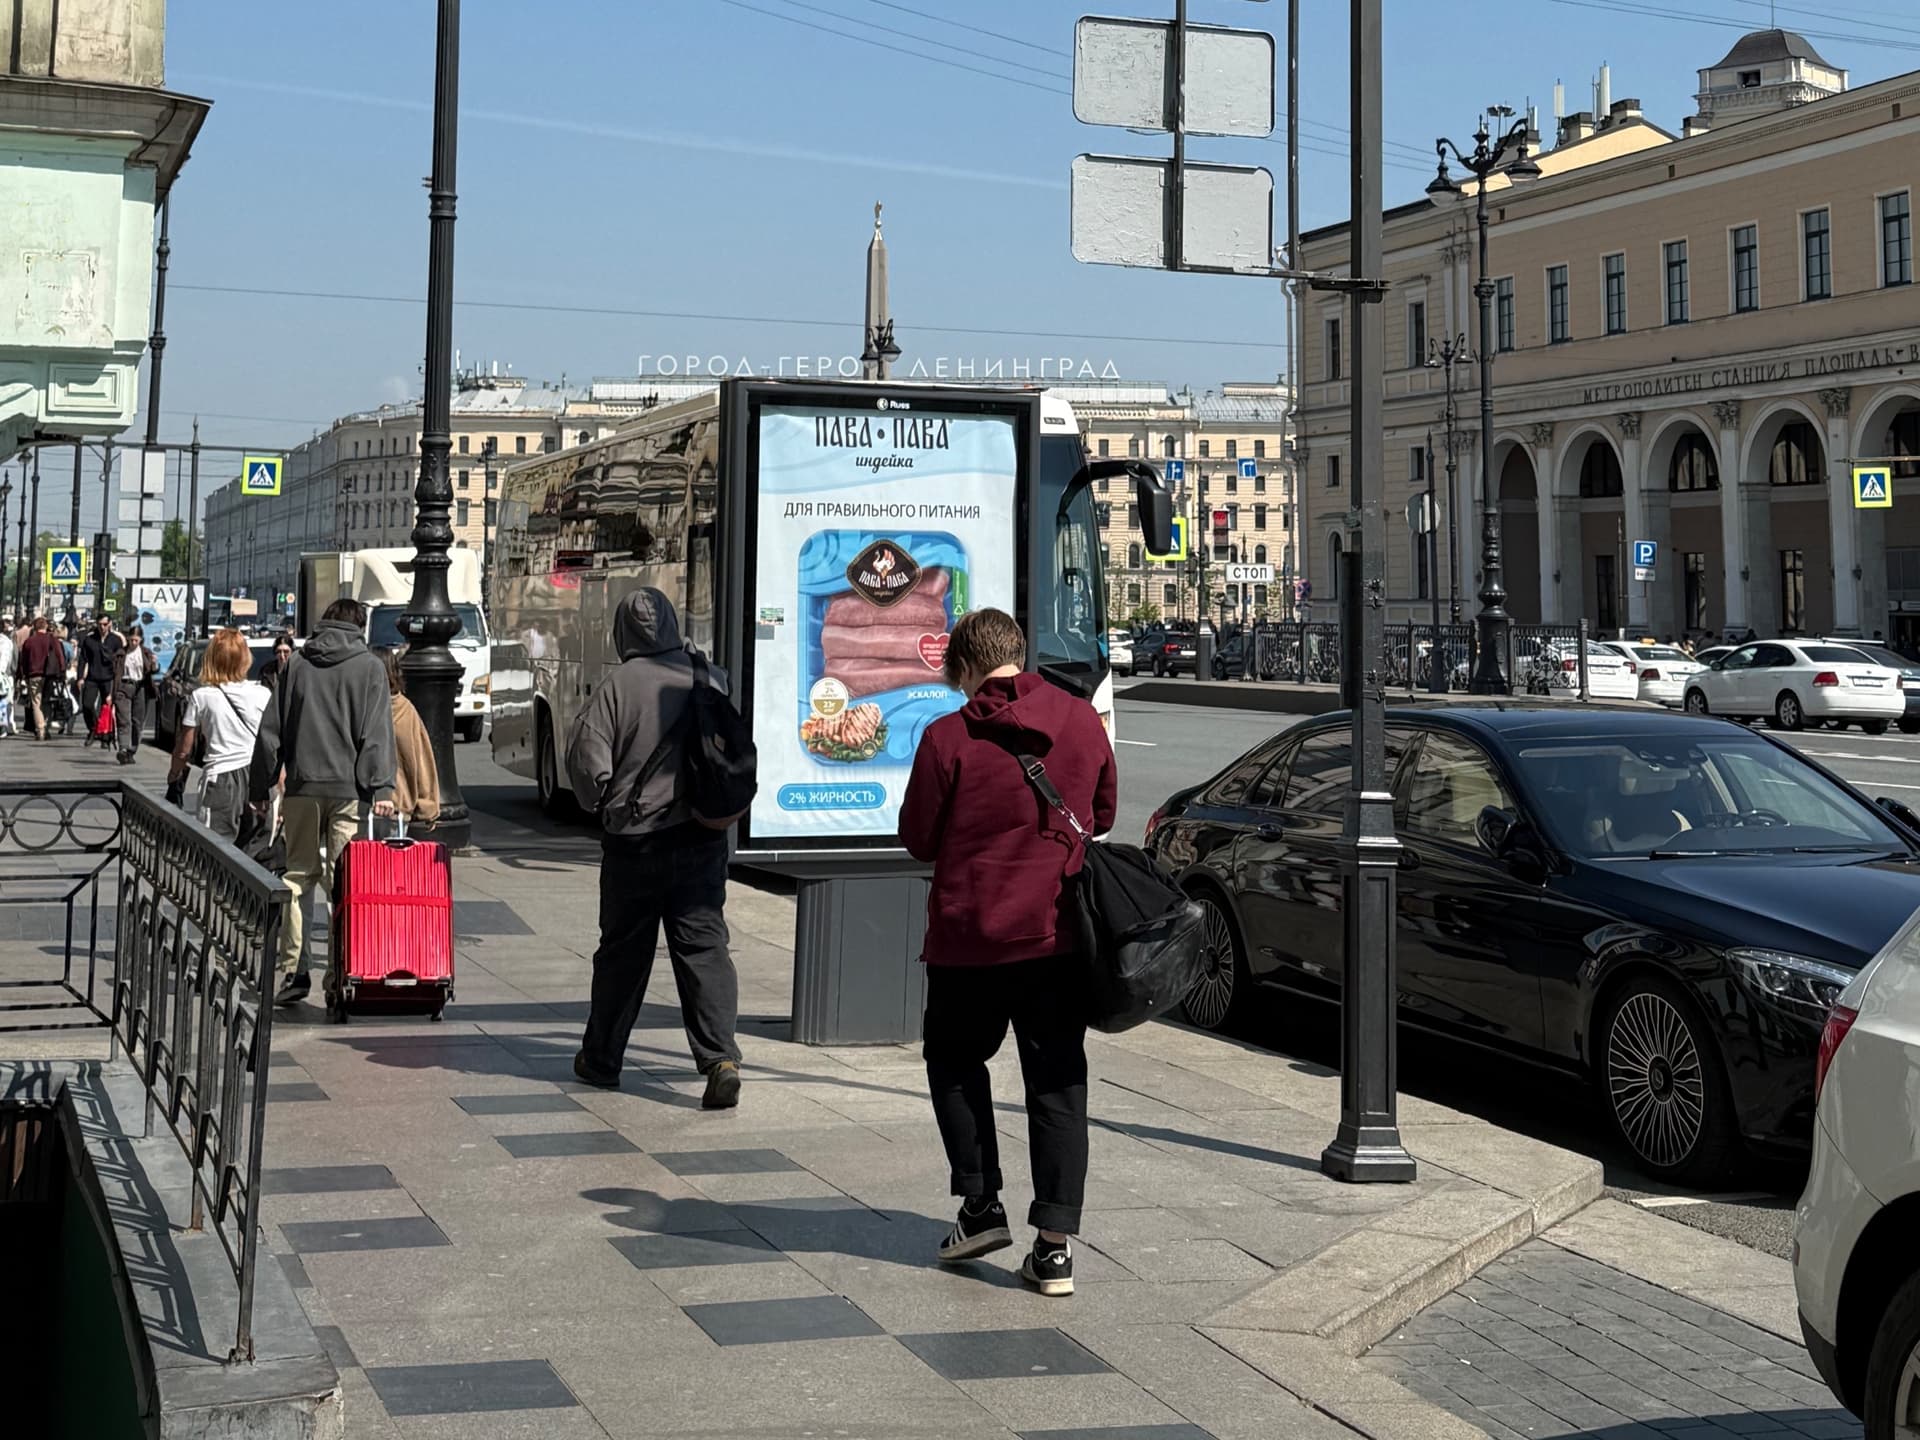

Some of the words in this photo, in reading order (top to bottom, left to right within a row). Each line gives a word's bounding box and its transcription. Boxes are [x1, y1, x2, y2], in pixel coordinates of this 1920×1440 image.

[638, 355, 859, 377] ГОРОД-ГЕРО
[910, 357, 1120, 378] ЛЕНИНГРАД
[1583, 374, 1702, 404] МЕТРОПОЛИТЕН
[1711, 362, 1791, 387] СТАНЦИЯ
[1805, 348, 1894, 376] ПЛОЩАДЬ
[856, 454, 913, 474] индейка
[784, 502, 813, 518] ДЛЯ
[816, 502, 916, 518] ПРАВИЛЬНОГО
[919, 504, 980, 519] ПИТАНИЯ
[1233, 567, 1267, 578] СТОП
[788, 792, 807, 804] 2%
[809, 790, 876, 803] ЖИРНОСТЬ
